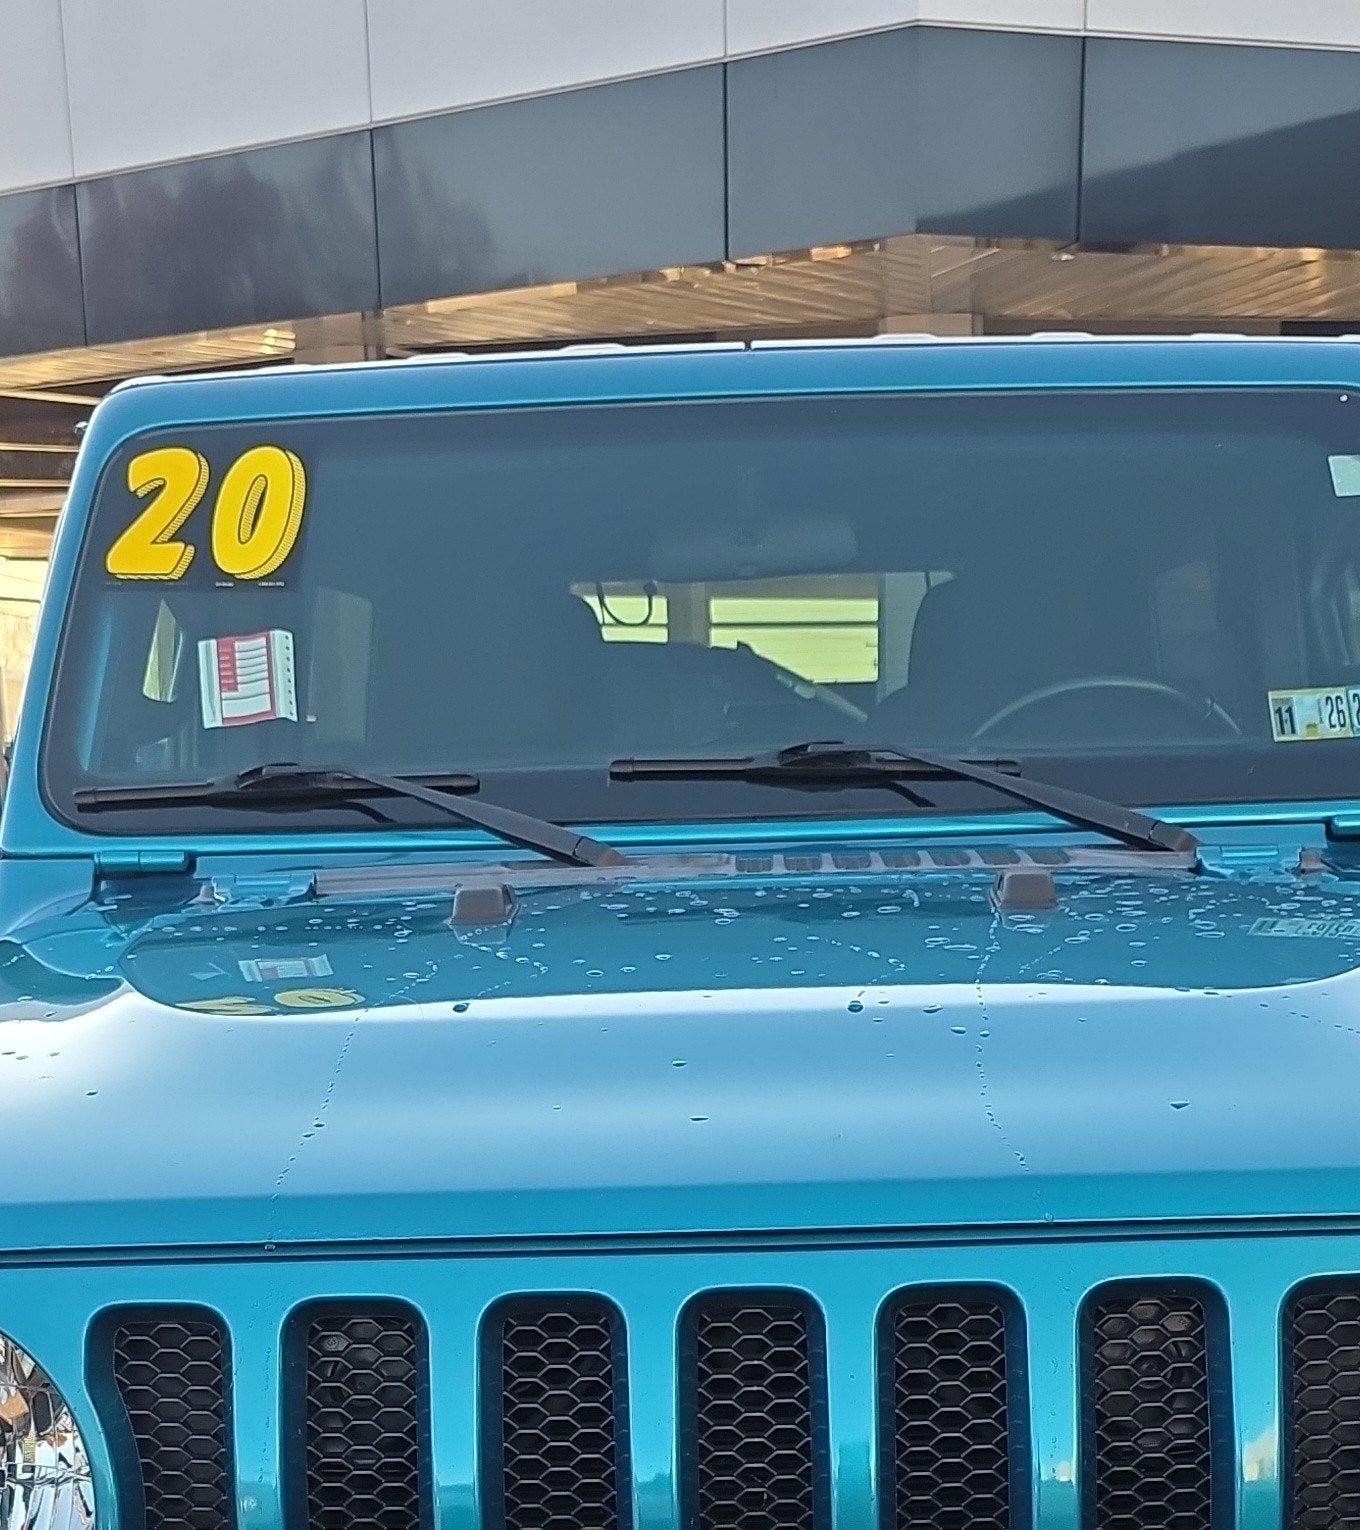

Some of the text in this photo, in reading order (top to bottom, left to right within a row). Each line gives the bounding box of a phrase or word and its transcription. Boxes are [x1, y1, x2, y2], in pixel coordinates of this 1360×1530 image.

[105, 445, 307, 581] 20
[1274, 695, 1347, 736] 11 26
